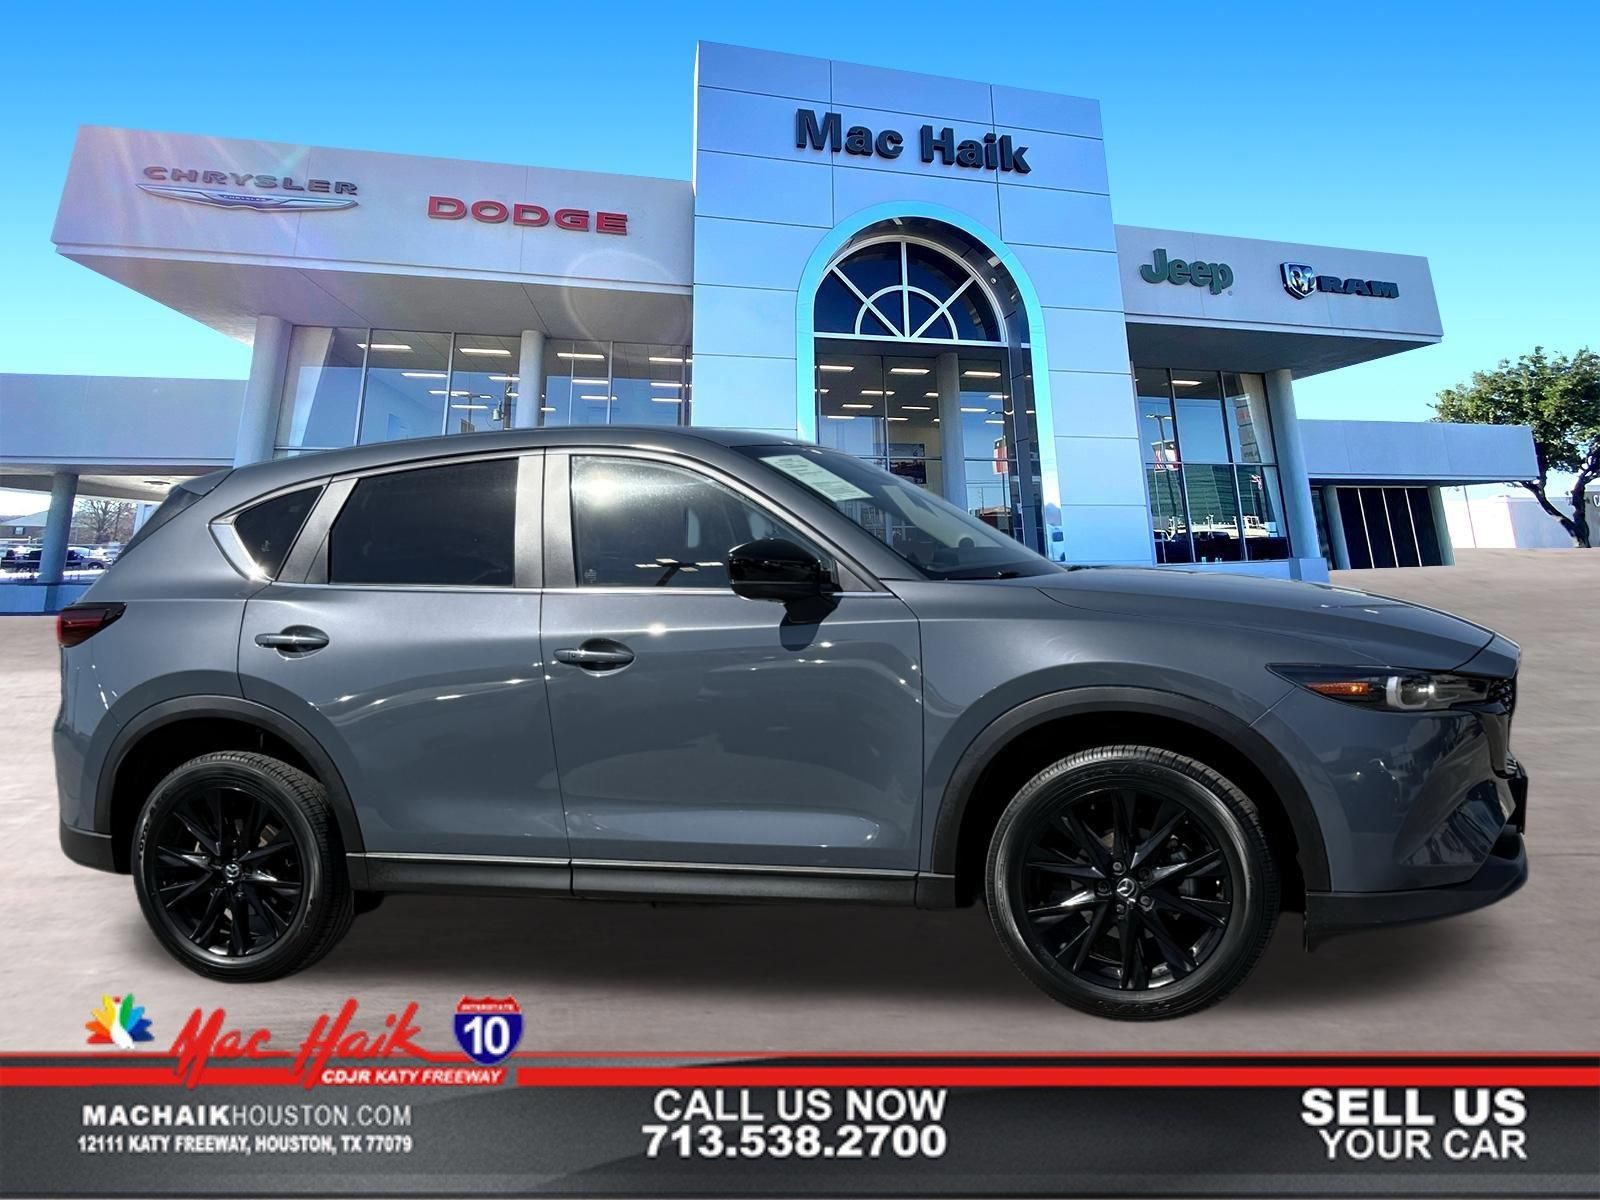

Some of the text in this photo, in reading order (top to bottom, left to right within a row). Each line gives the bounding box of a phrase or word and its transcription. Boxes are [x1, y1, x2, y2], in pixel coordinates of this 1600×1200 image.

[796, 108, 1032, 174] Mac Haik
[143, 166, 358, 196] CHRYSLER
[428, 196, 628, 236] DODGE
[1139, 248, 1234, 296] Jeep
[1315, 275, 1399, 299] RAM
